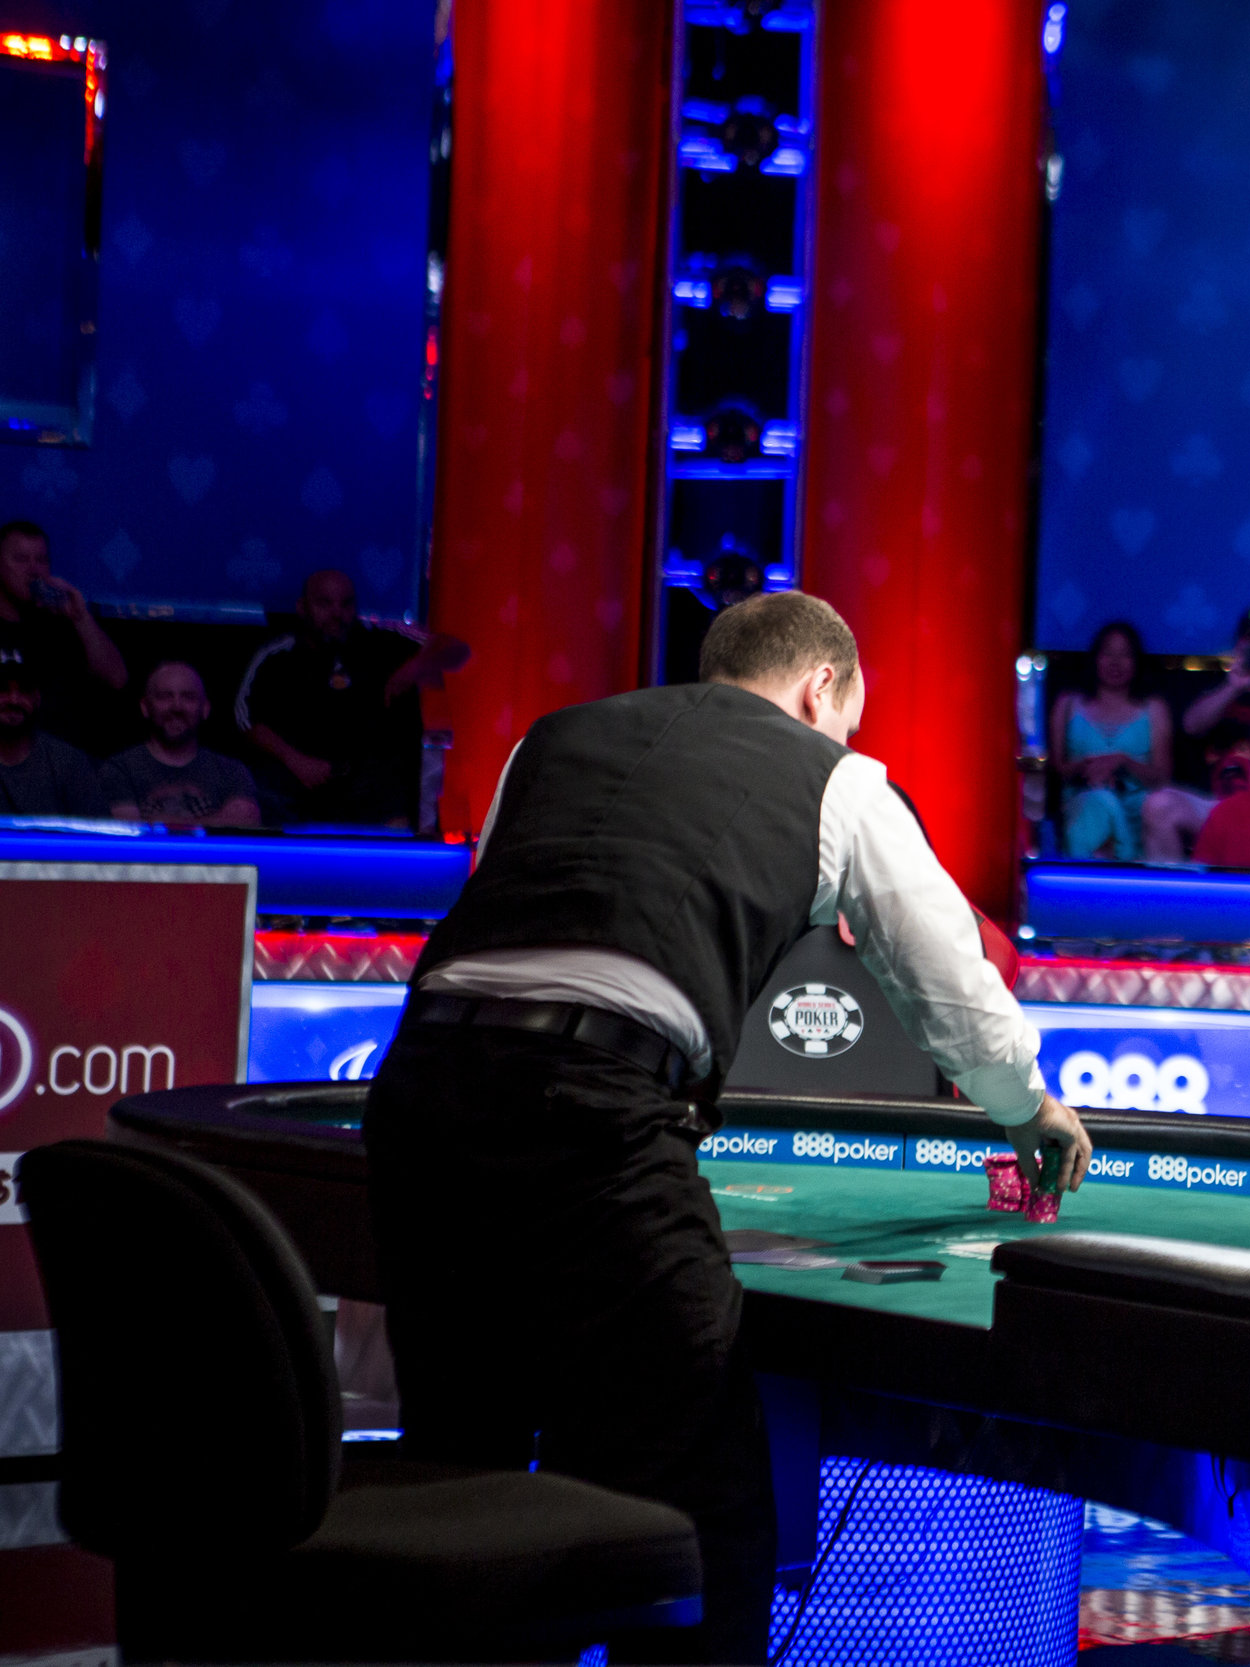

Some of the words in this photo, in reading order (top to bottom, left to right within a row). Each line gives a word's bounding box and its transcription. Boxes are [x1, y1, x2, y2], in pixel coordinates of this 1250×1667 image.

[795, 1010, 839, 1026] POKER
[35, 1044, 175, 1096] .com
[792, 1131, 898, 1164] 888poker
[1148, 1154, 1248, 1188] 888poker
